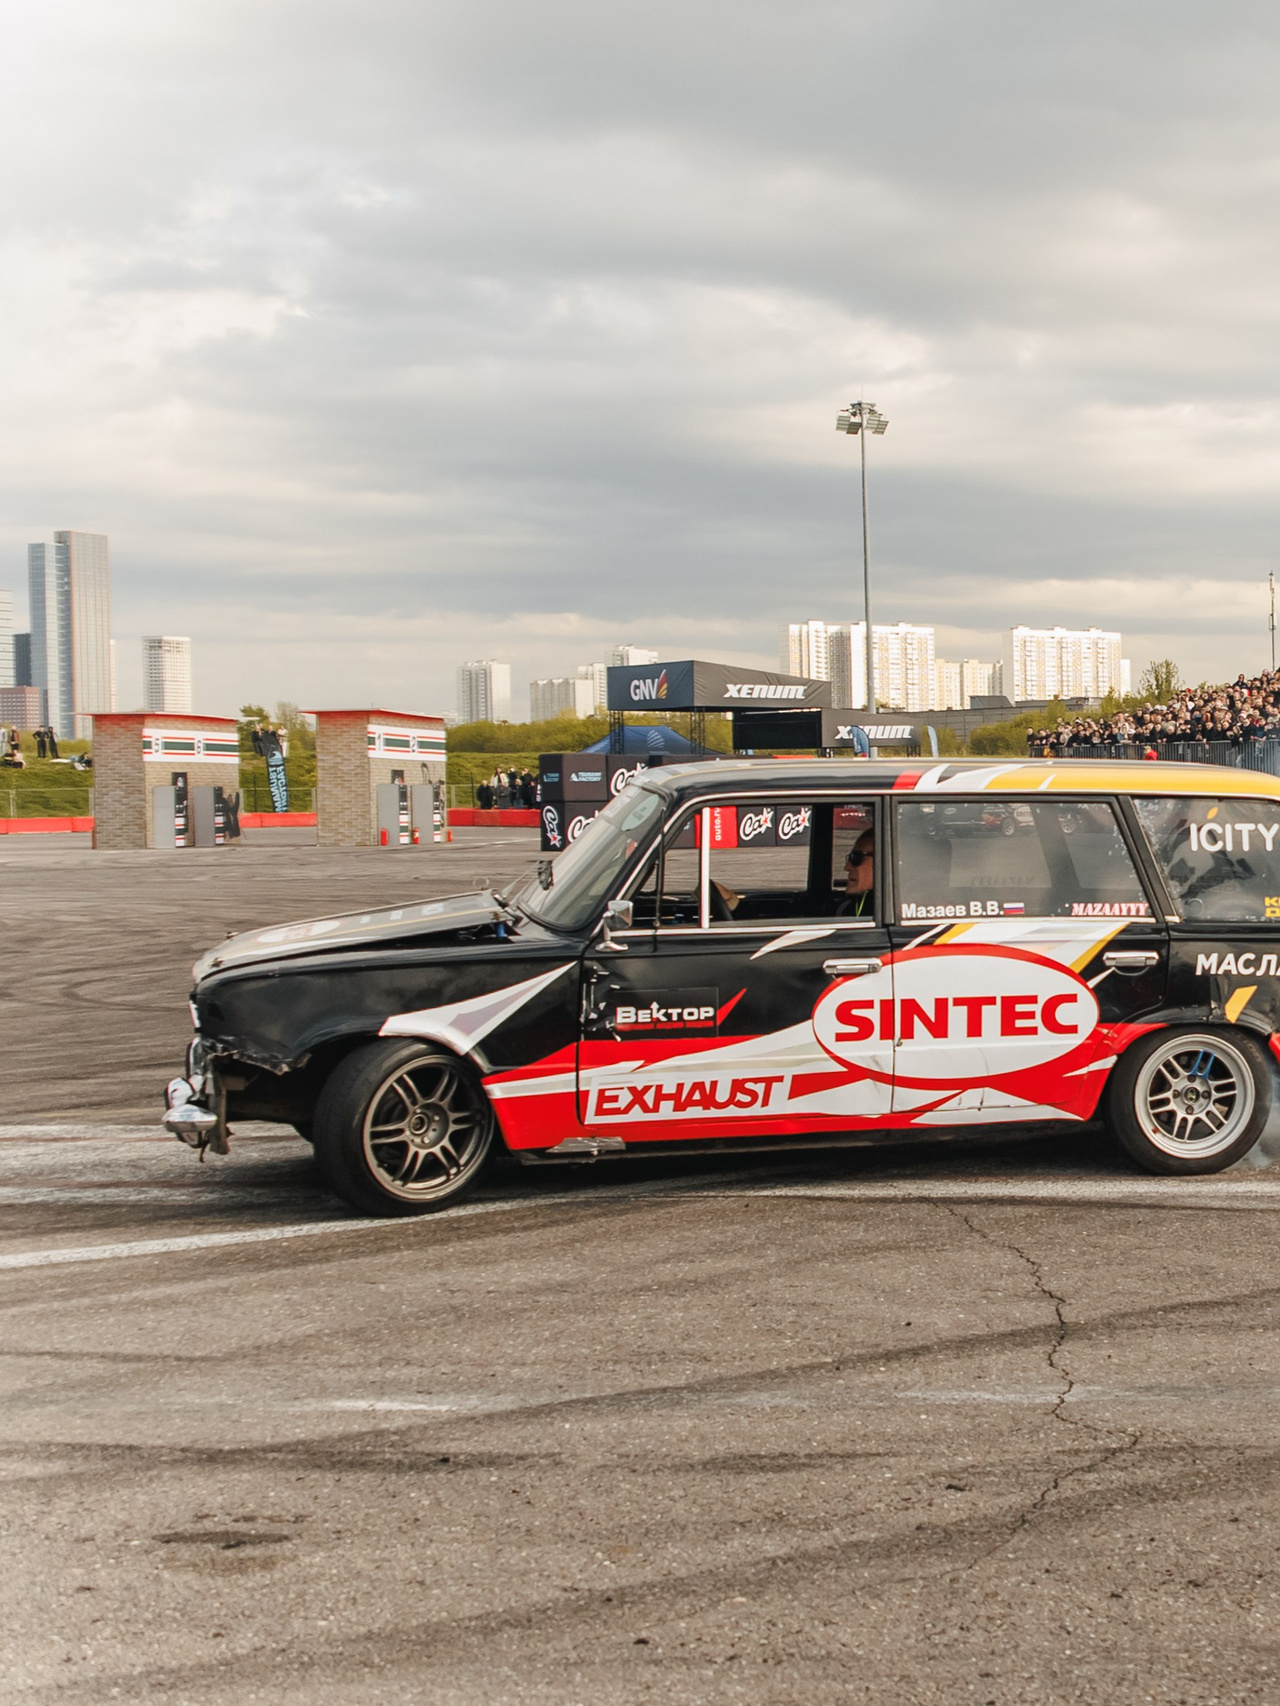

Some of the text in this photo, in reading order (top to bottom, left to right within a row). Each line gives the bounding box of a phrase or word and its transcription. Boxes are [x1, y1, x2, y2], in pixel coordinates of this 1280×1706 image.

[629, 678, 658, 701] GNV
[834, 725, 914, 740] XNUM
[901, 901, 1004, 919] Мазаев В.В.
[835, 993, 1078, 1042] SINTEC
[594, 1075, 785, 1117] EXHAUST
